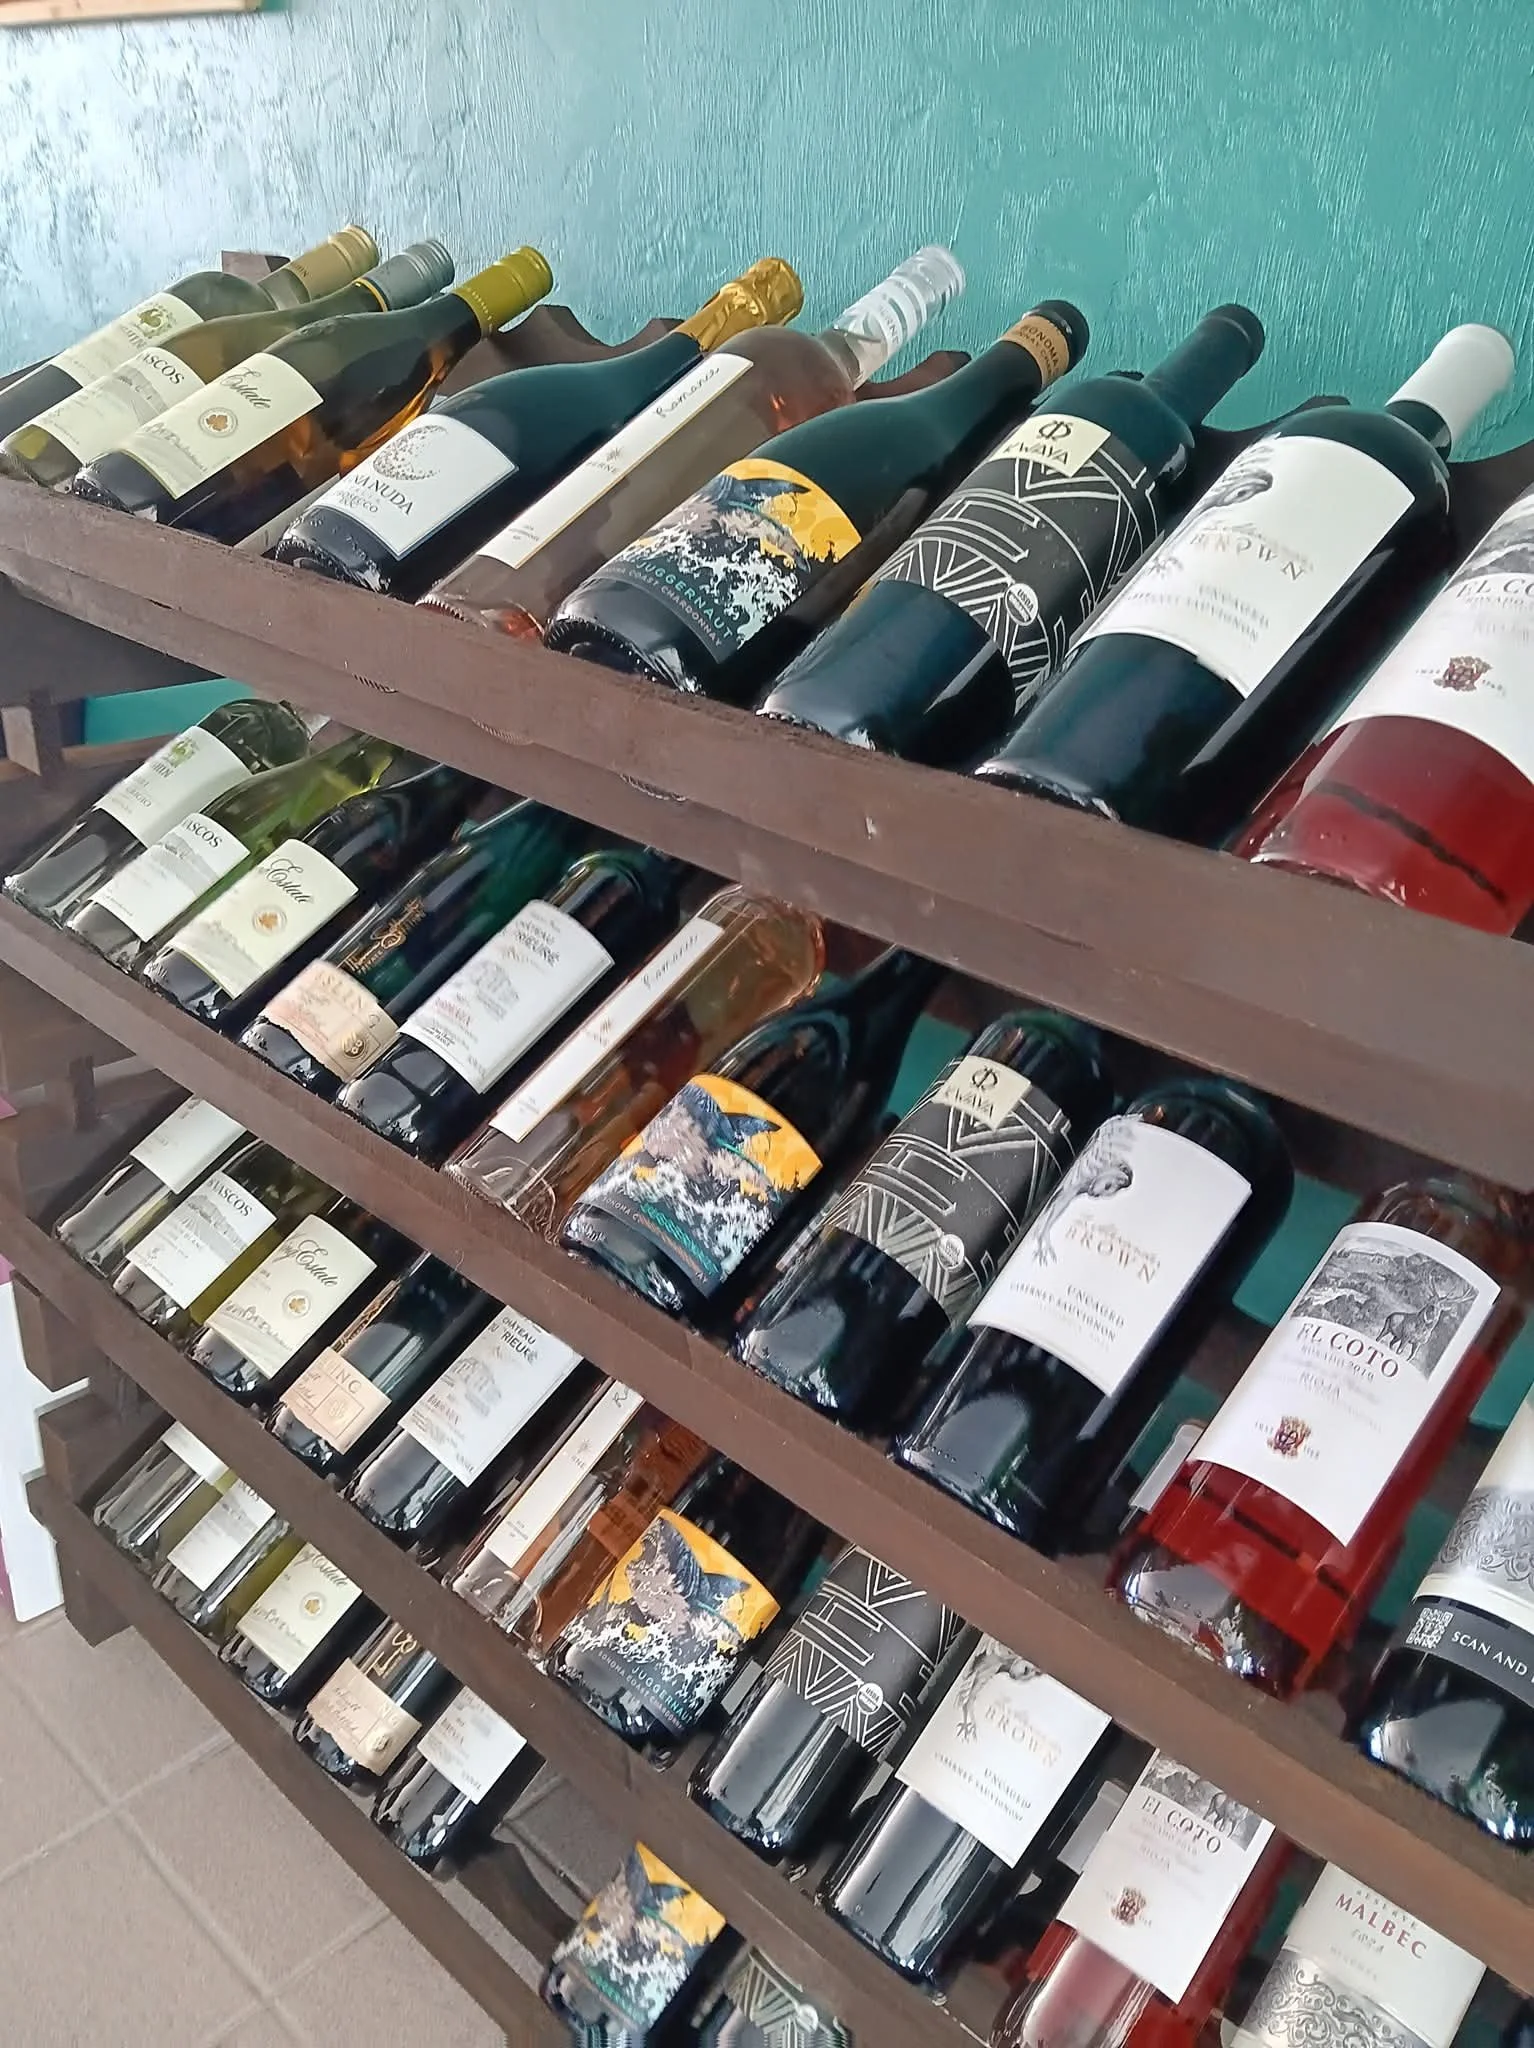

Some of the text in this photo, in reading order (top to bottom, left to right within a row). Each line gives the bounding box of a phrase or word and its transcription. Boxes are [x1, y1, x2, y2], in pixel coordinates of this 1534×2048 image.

[222, 366, 272, 409] Estate
[367, 481, 415, 516] NUDA
[636, 558, 733, 640] JUGGERNAUT
[660, 584, 723, 647] CHARDONNAY
[294, 1237, 341, 1288] Estate
[501, 1315, 537, 1345] CHÂTEAU
[1329, 1330, 1401, 1379] COTO
[1451, 1631, 1529, 1676] SCAN AND
[631, 1666, 694, 1724] JUGGERNAUT
[1167, 1808, 1222, 1855] COTO
[1335, 1892, 1428, 1960] MALBEC
